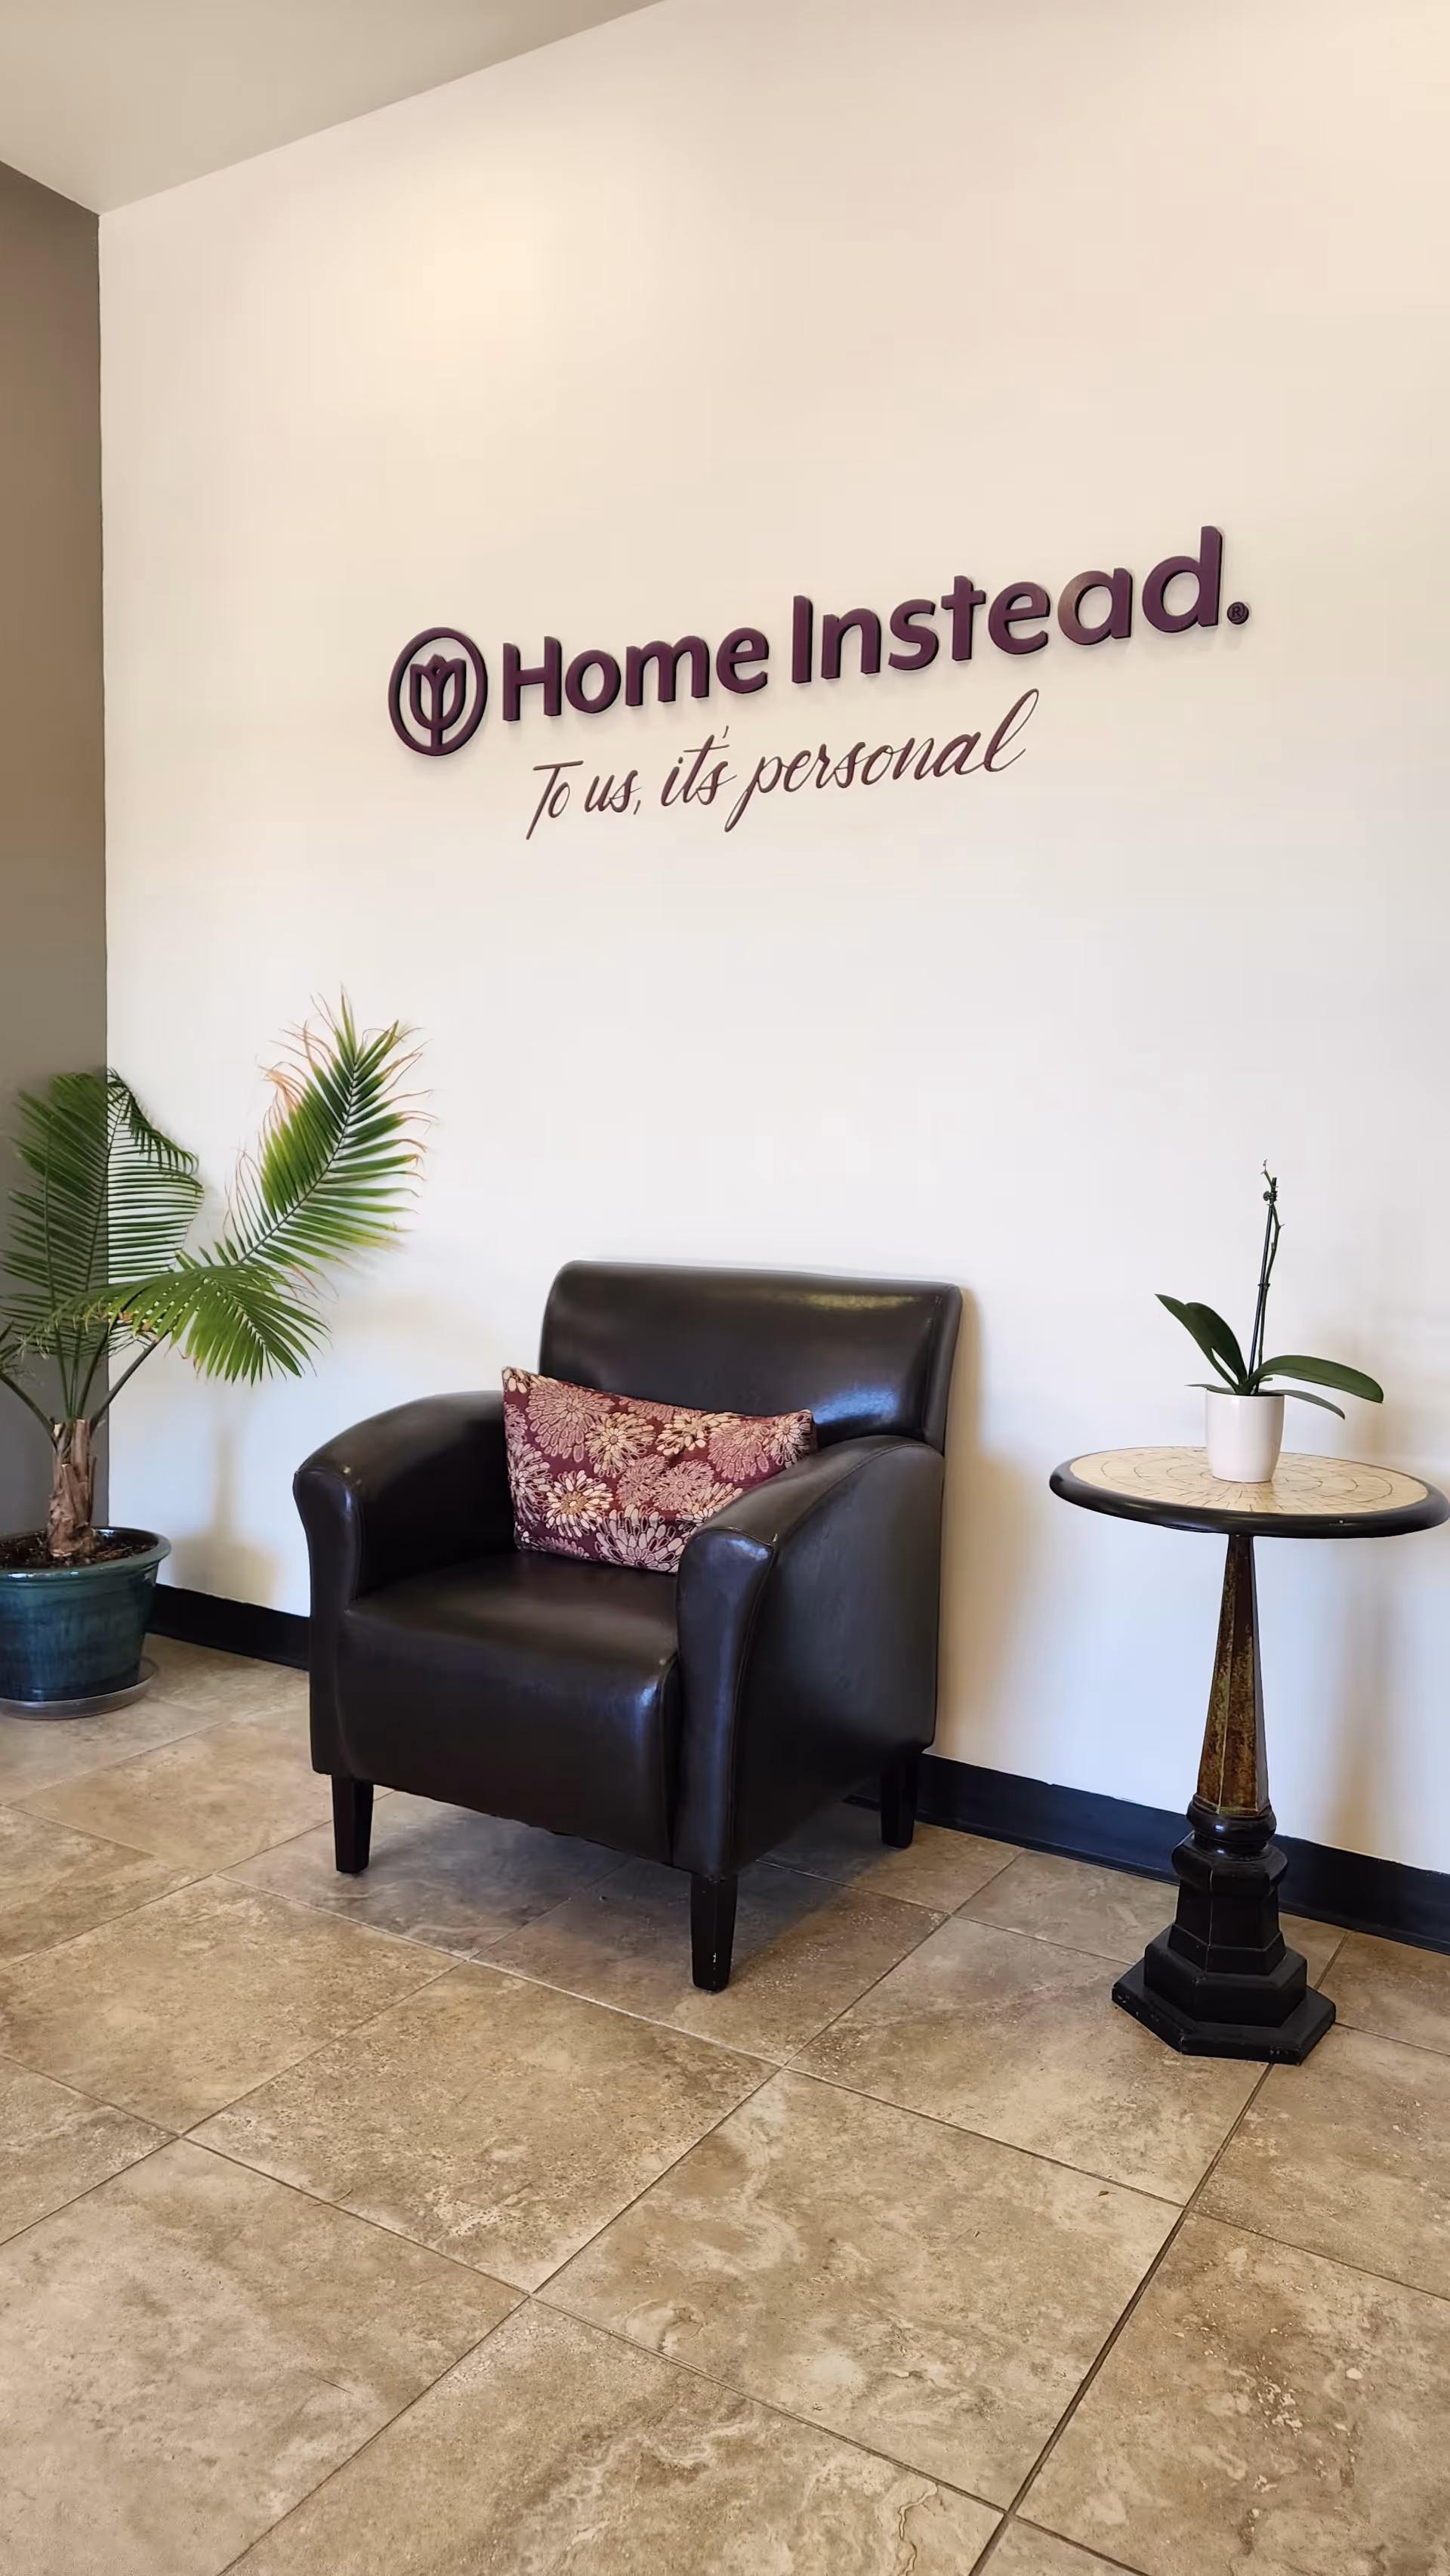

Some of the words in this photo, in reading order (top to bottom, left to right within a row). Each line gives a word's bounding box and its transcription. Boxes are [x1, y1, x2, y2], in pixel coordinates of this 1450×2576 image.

[502, 628, 770, 722] Home
[526, 760, 584, 840] To
[584, 769, 642, 815] us,
[659, 725, 738, 807] it's
[723, 688, 1039, 833] personal
